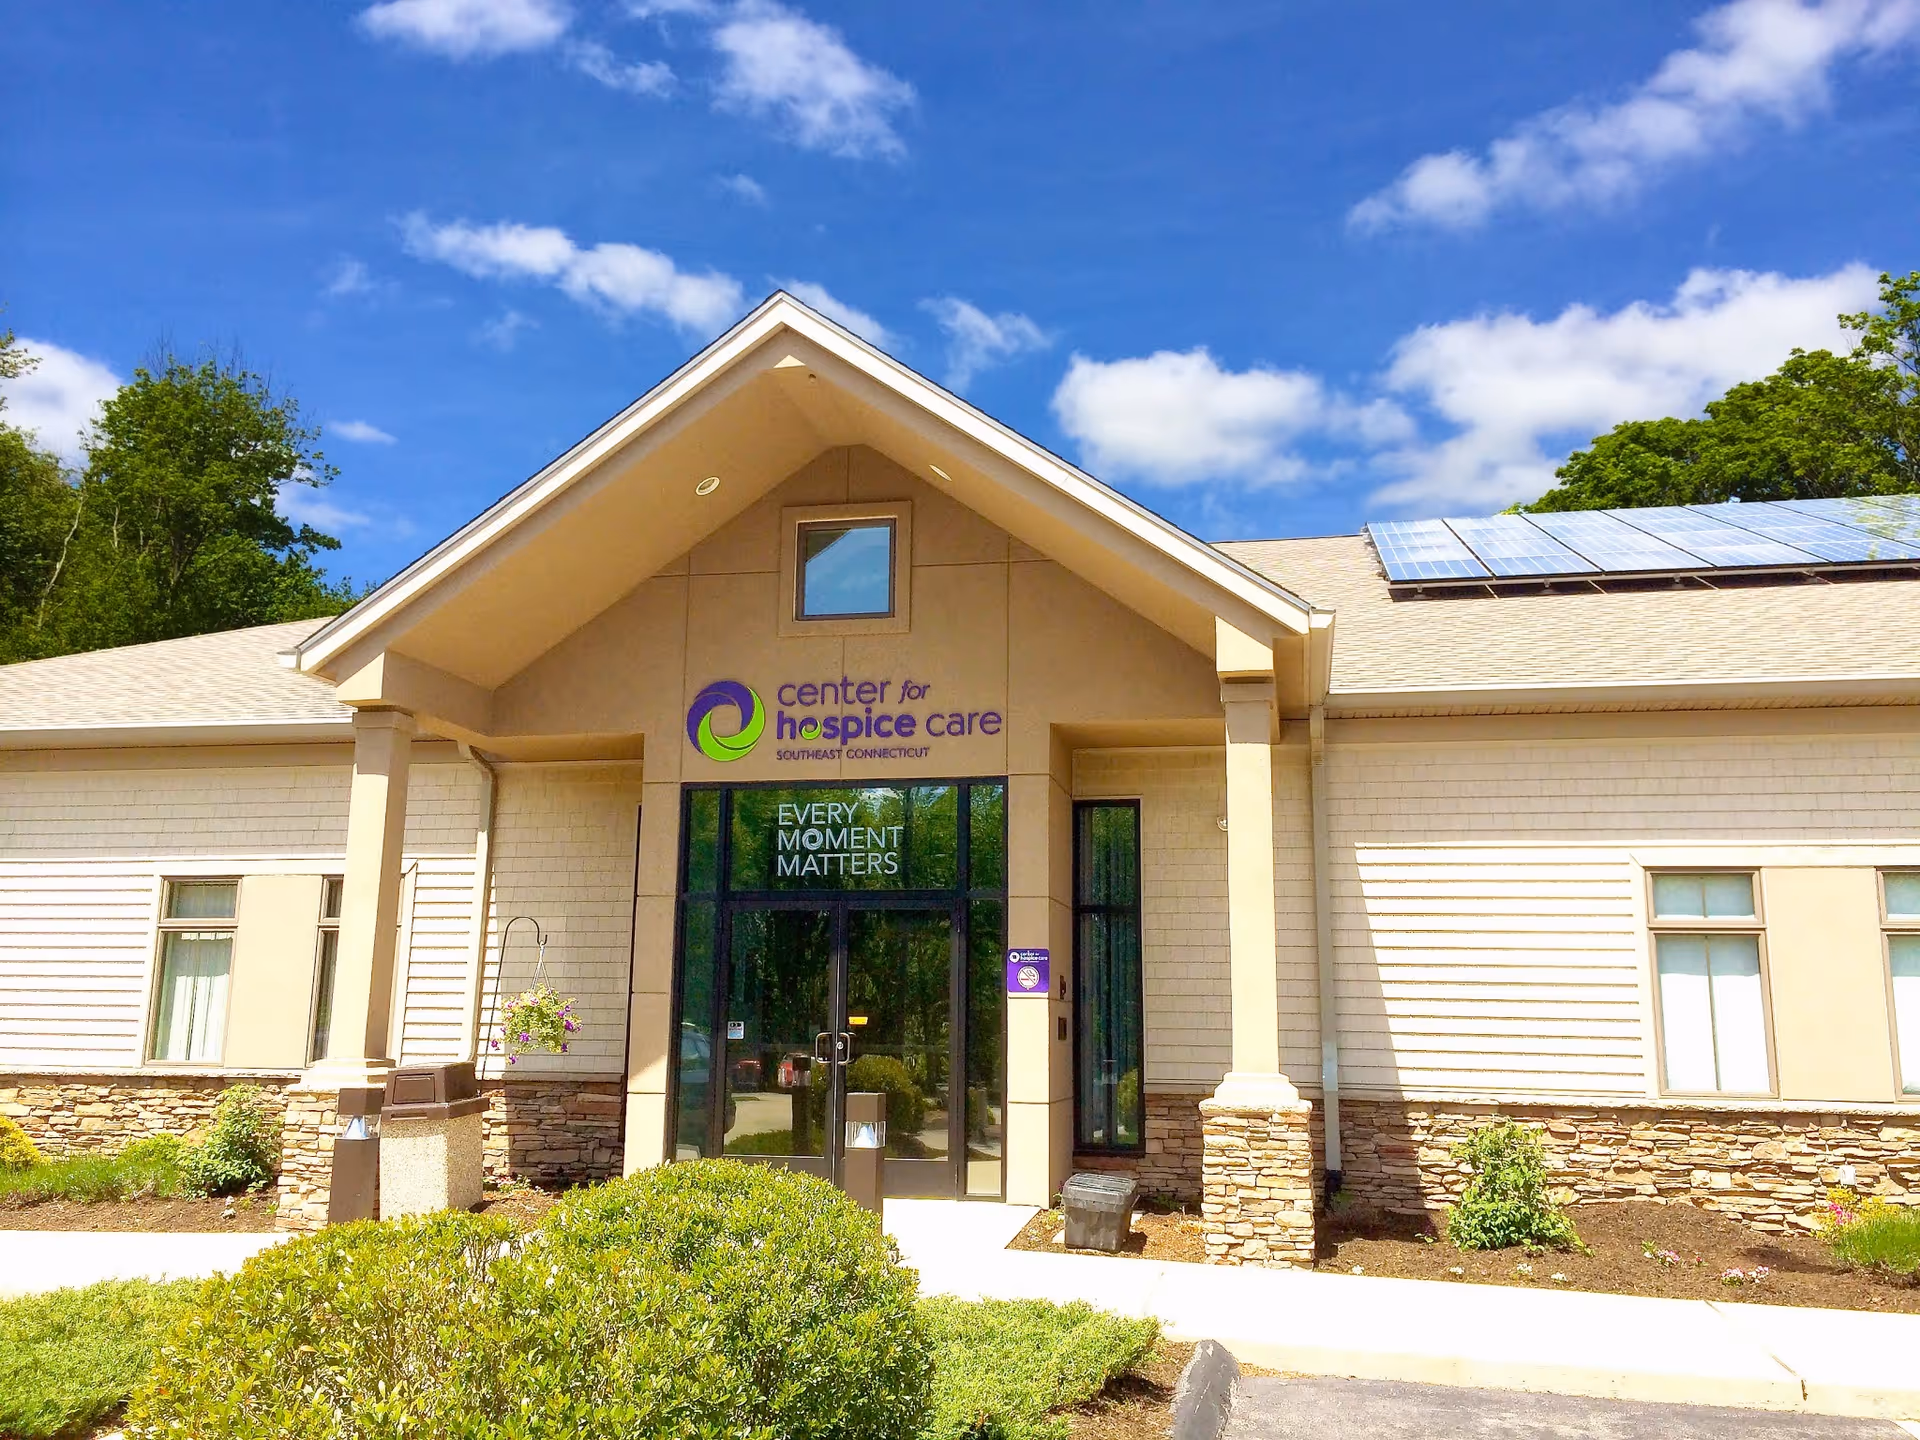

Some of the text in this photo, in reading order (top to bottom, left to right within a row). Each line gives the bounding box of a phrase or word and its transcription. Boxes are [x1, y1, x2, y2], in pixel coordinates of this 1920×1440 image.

[777, 676, 931, 706] center for
[776, 707, 1002, 745] hospice care
[776, 746, 930, 760] SOUTHEAST CONNECTICUT
[778, 802, 859, 826] EVERY
[778, 827, 904, 851] MOMENT
[777, 852, 898, 876] MATTERS
